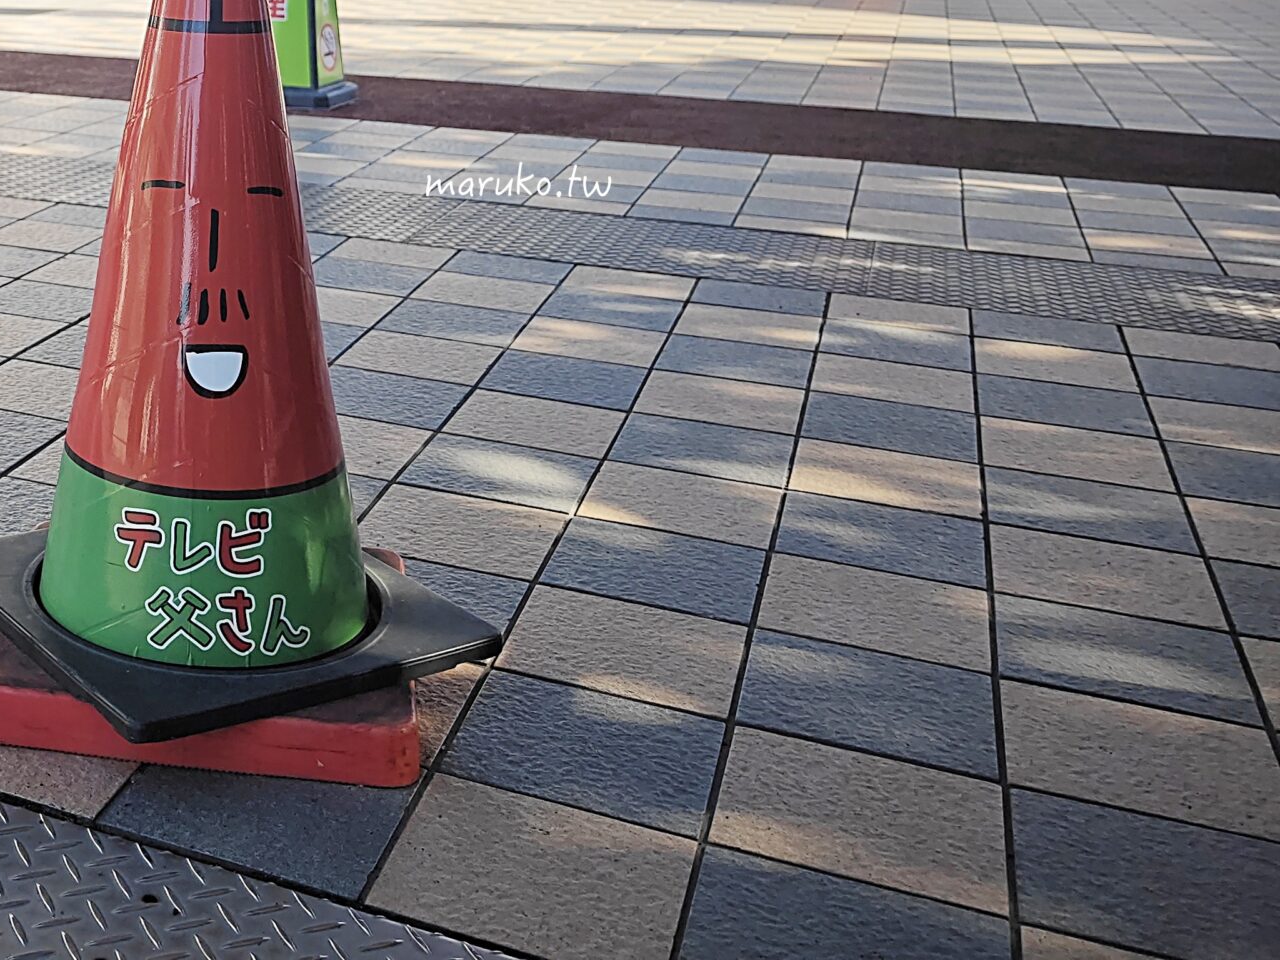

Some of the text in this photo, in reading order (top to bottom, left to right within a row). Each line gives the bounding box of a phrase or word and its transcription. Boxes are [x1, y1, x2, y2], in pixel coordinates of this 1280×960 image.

[115, 507, 271, 578] テレビ
[145, 586, 310, 656] 父さん
